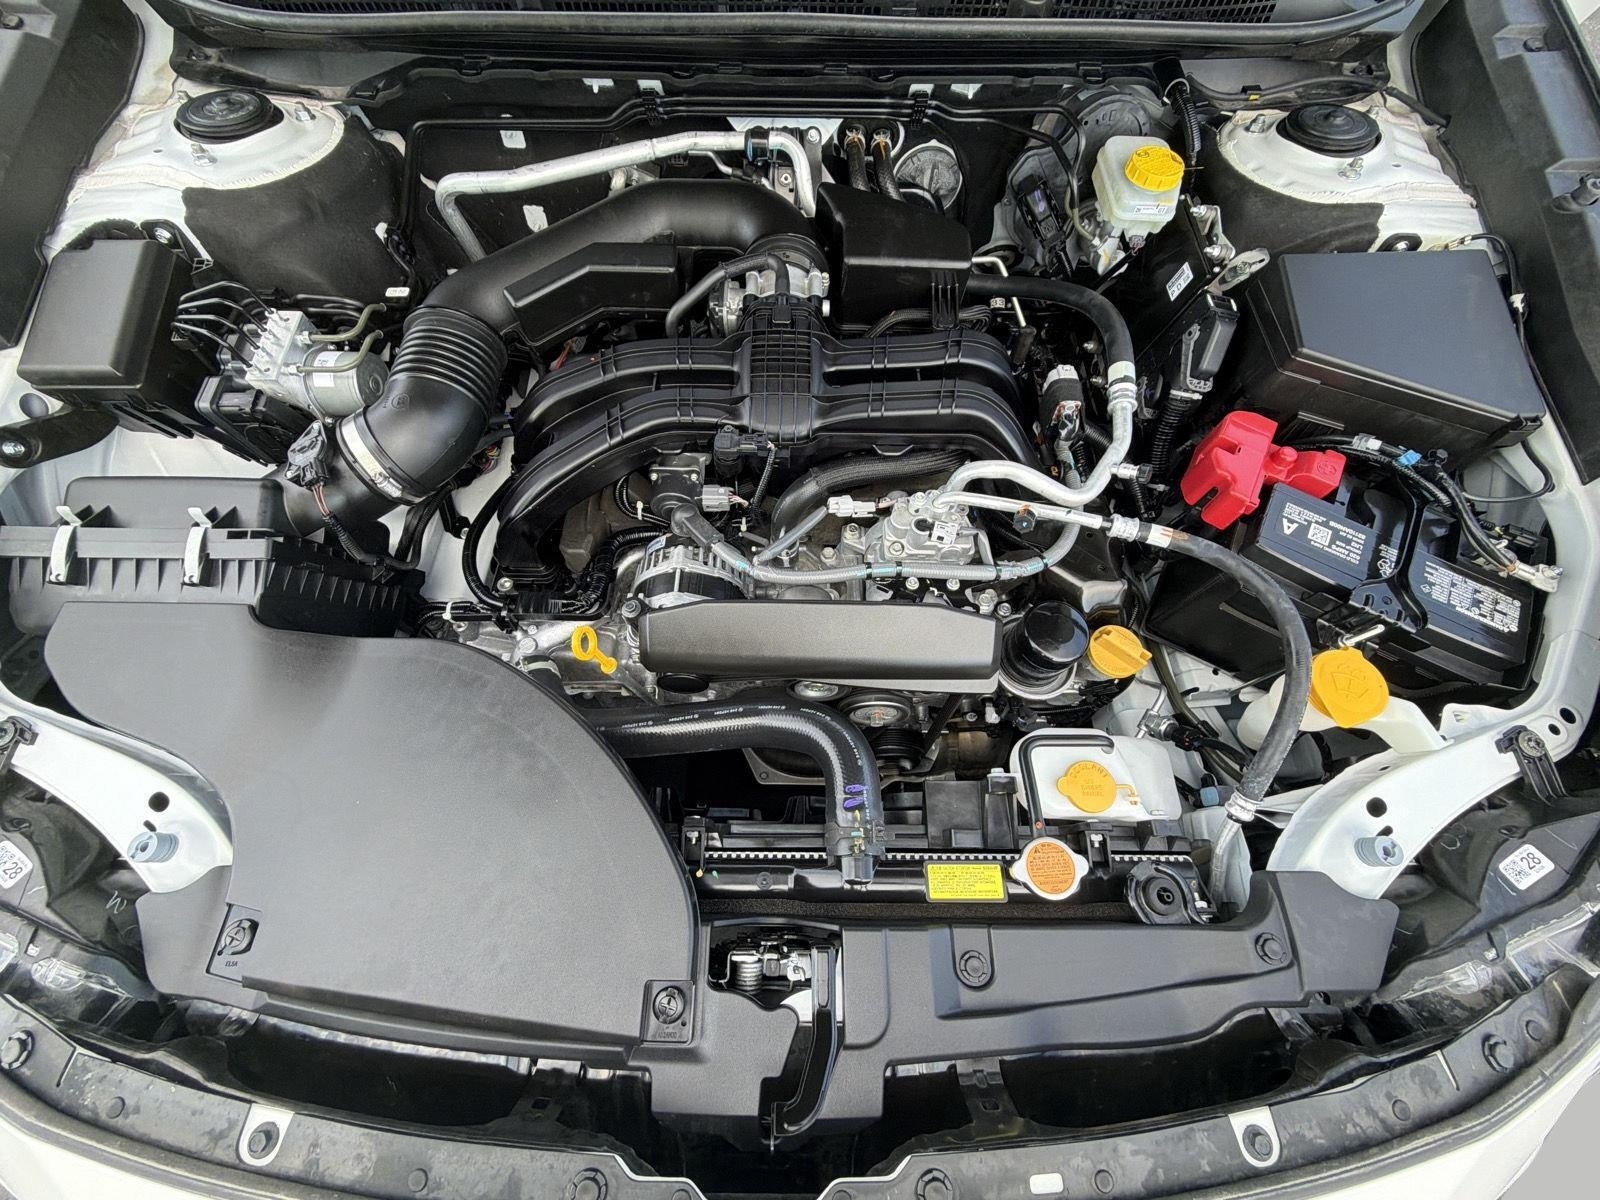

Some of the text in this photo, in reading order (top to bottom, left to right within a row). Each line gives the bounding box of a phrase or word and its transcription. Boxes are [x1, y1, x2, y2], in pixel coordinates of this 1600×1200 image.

[1282, 518, 1299, 535] A
[1520, 852, 1542, 870] 28
[3, 862, 23, 879] 28
